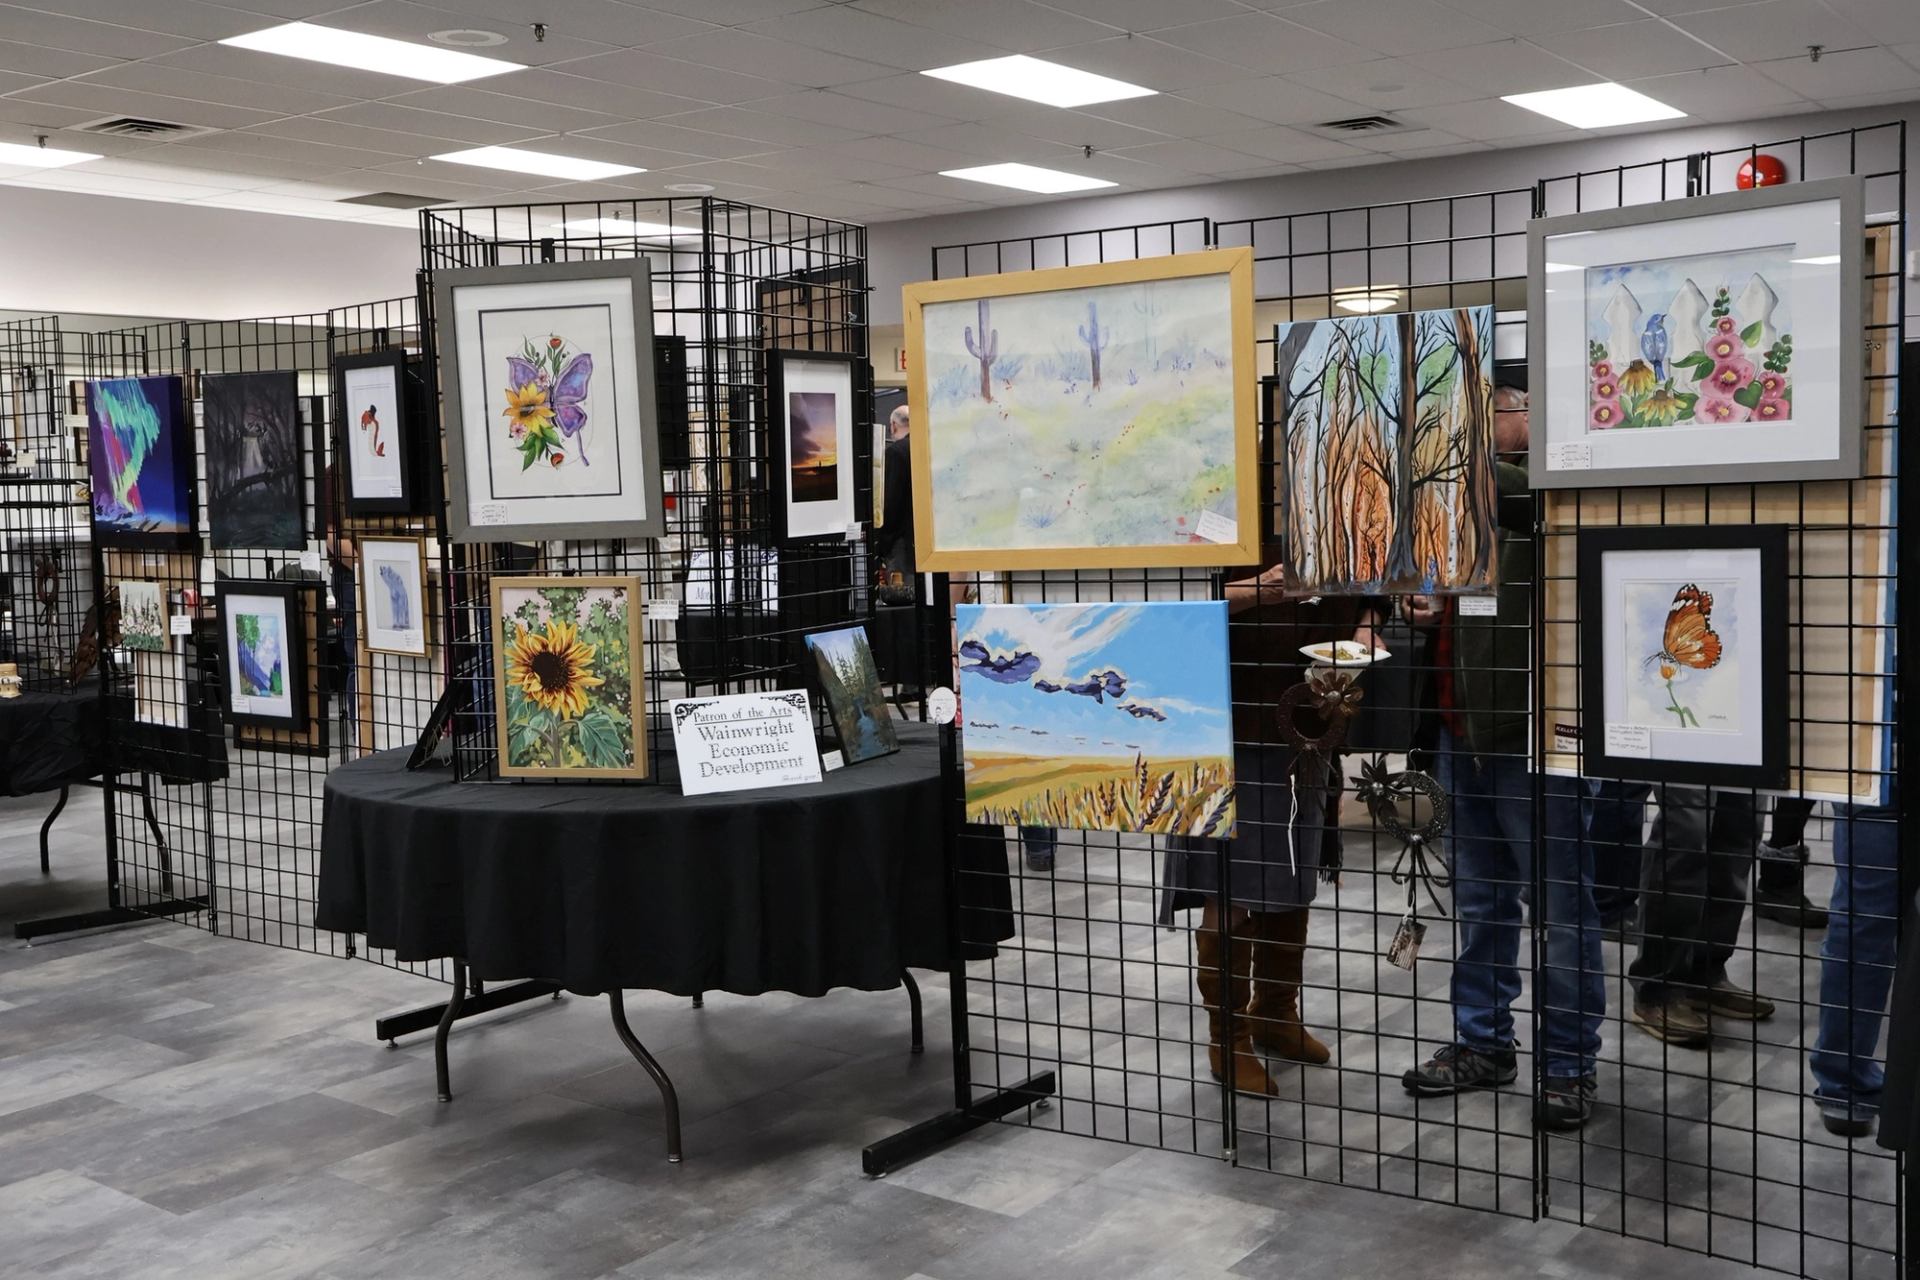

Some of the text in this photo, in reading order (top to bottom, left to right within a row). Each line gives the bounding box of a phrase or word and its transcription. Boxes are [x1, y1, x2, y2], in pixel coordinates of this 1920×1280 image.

[693, 706, 793, 723] Patron of the Arts
[698, 719, 795, 741] Wainwright
[709, 739, 789, 759] Economic
[699, 757, 804, 778] Development
